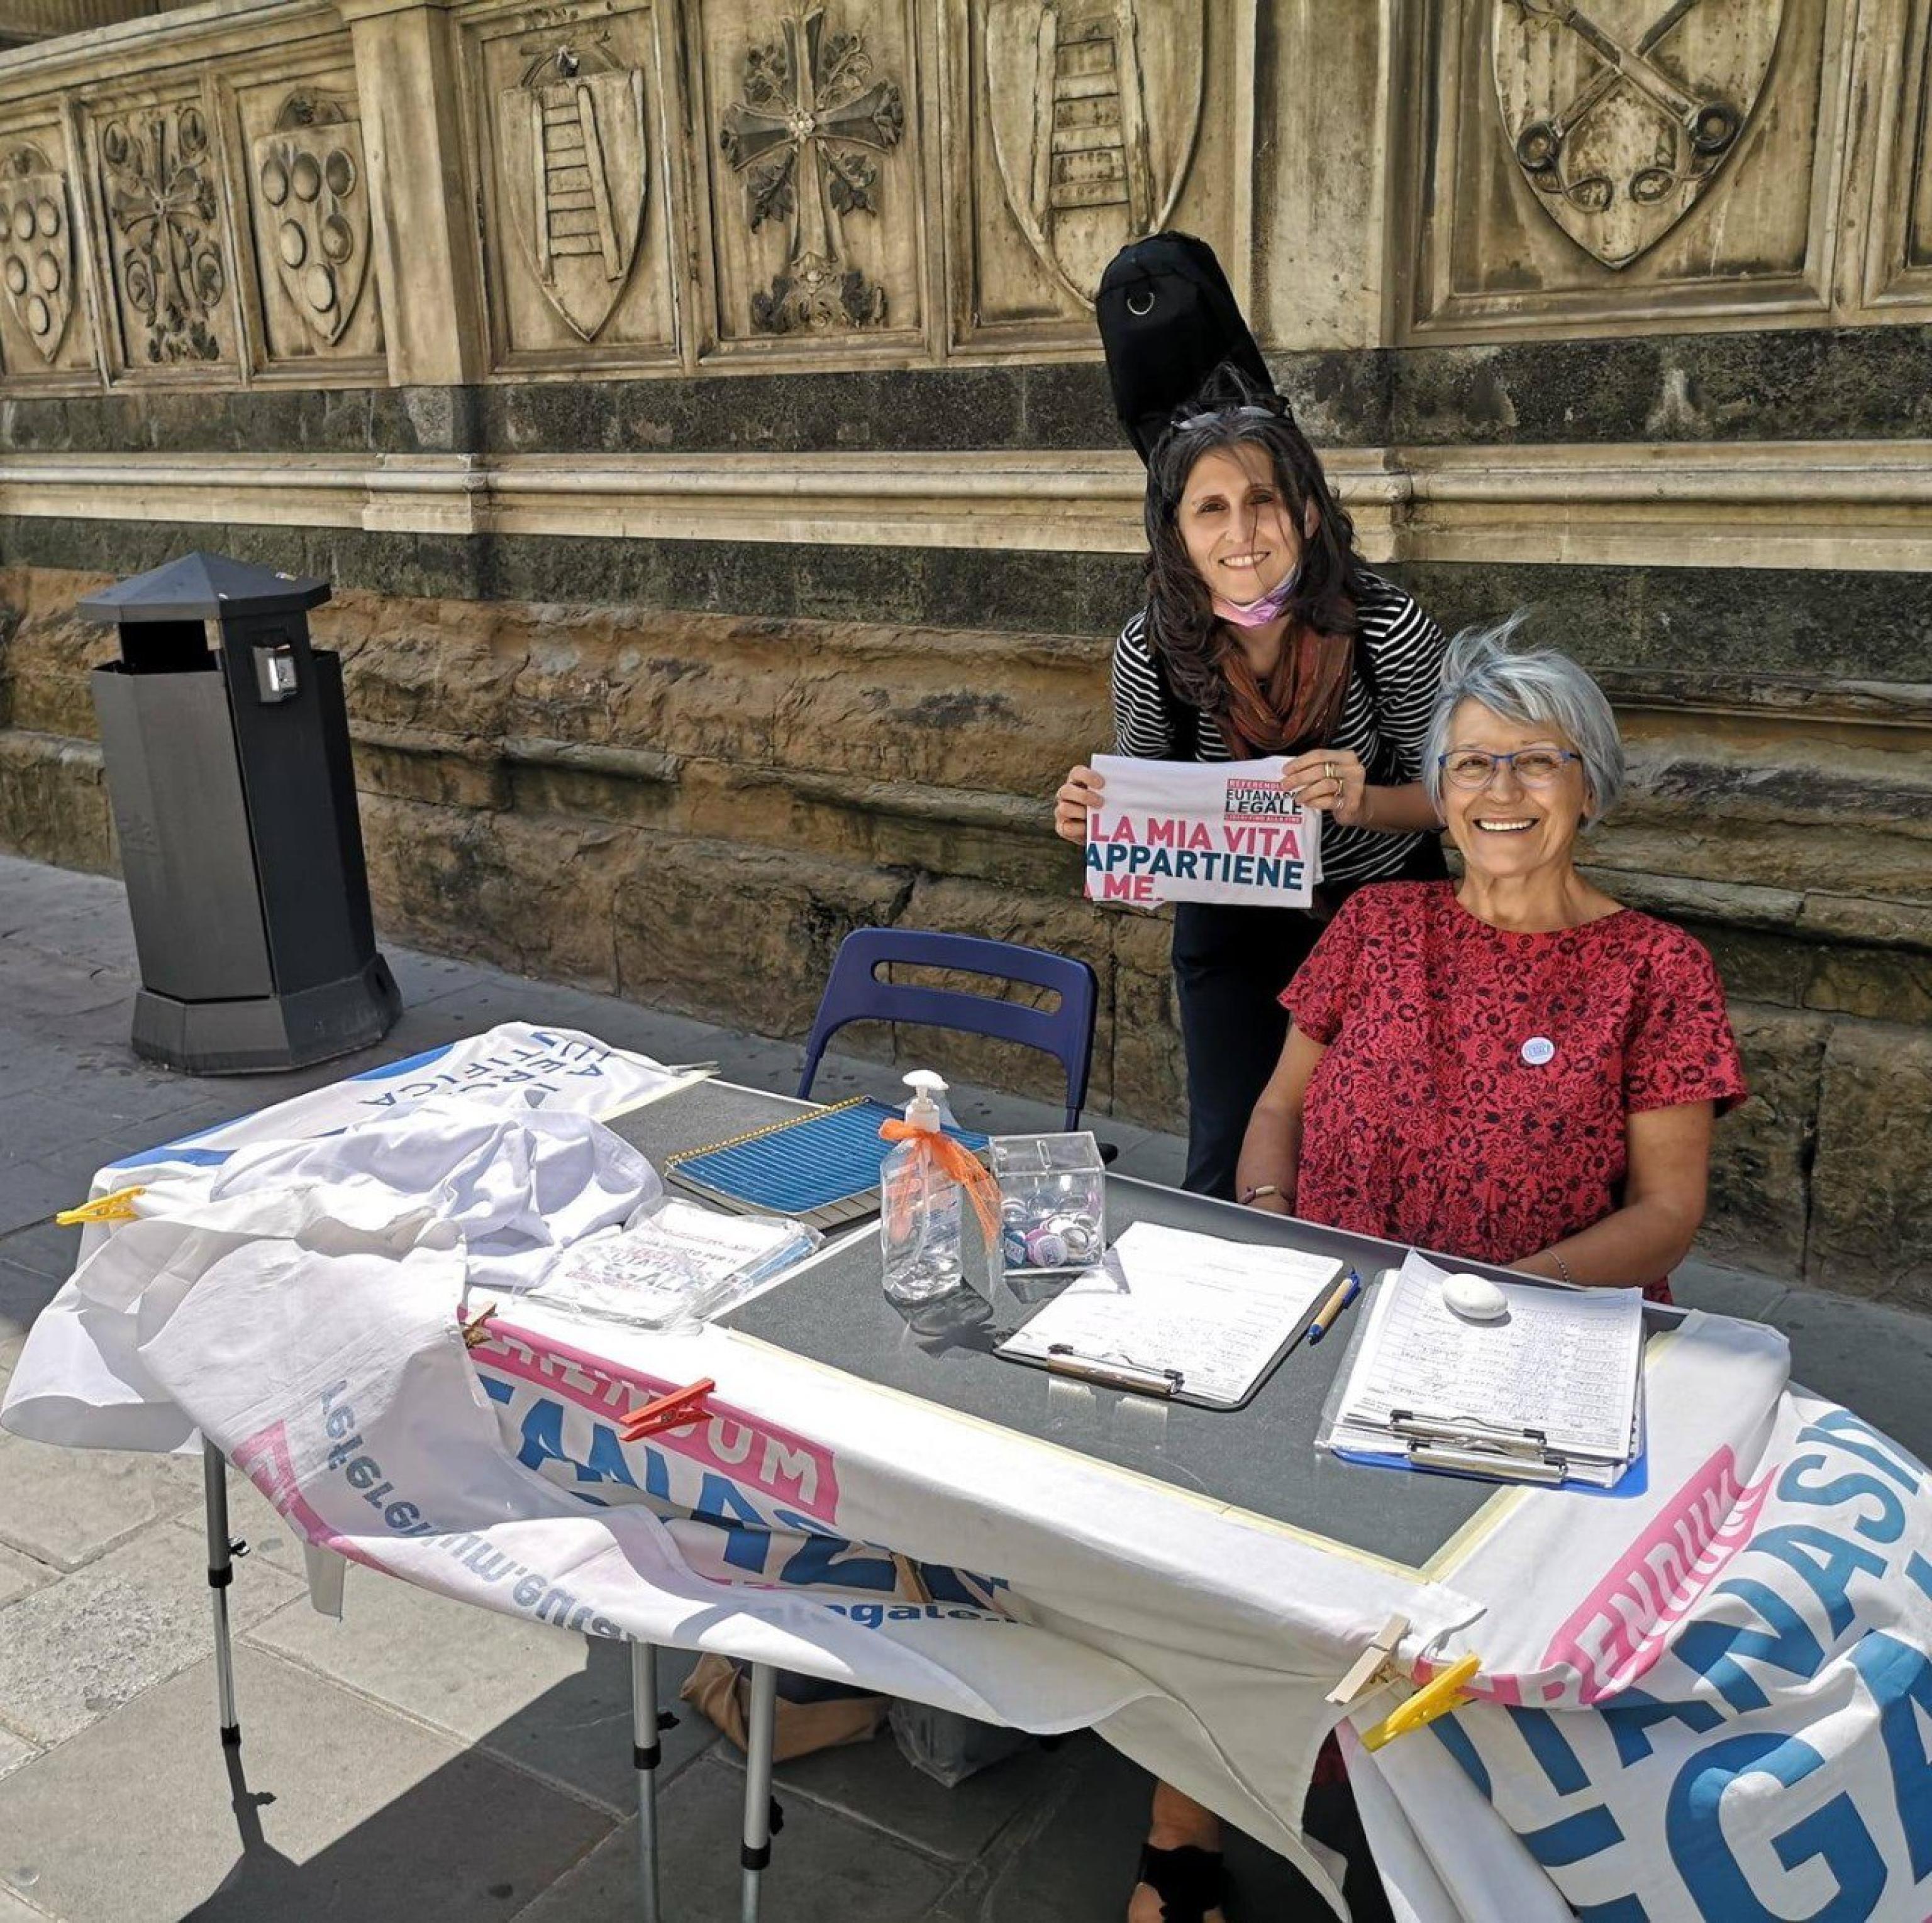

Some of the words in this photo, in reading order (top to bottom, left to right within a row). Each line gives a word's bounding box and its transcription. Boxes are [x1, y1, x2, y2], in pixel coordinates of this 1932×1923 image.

[1226, 799, 1302, 814] LEGALE
[1091, 813, 1136, 843] LA
[1146, 817, 1213, 851] MIA
[1223, 825, 1300, 860] VITA
[1086, 843, 1305, 891] APPARTIENE
